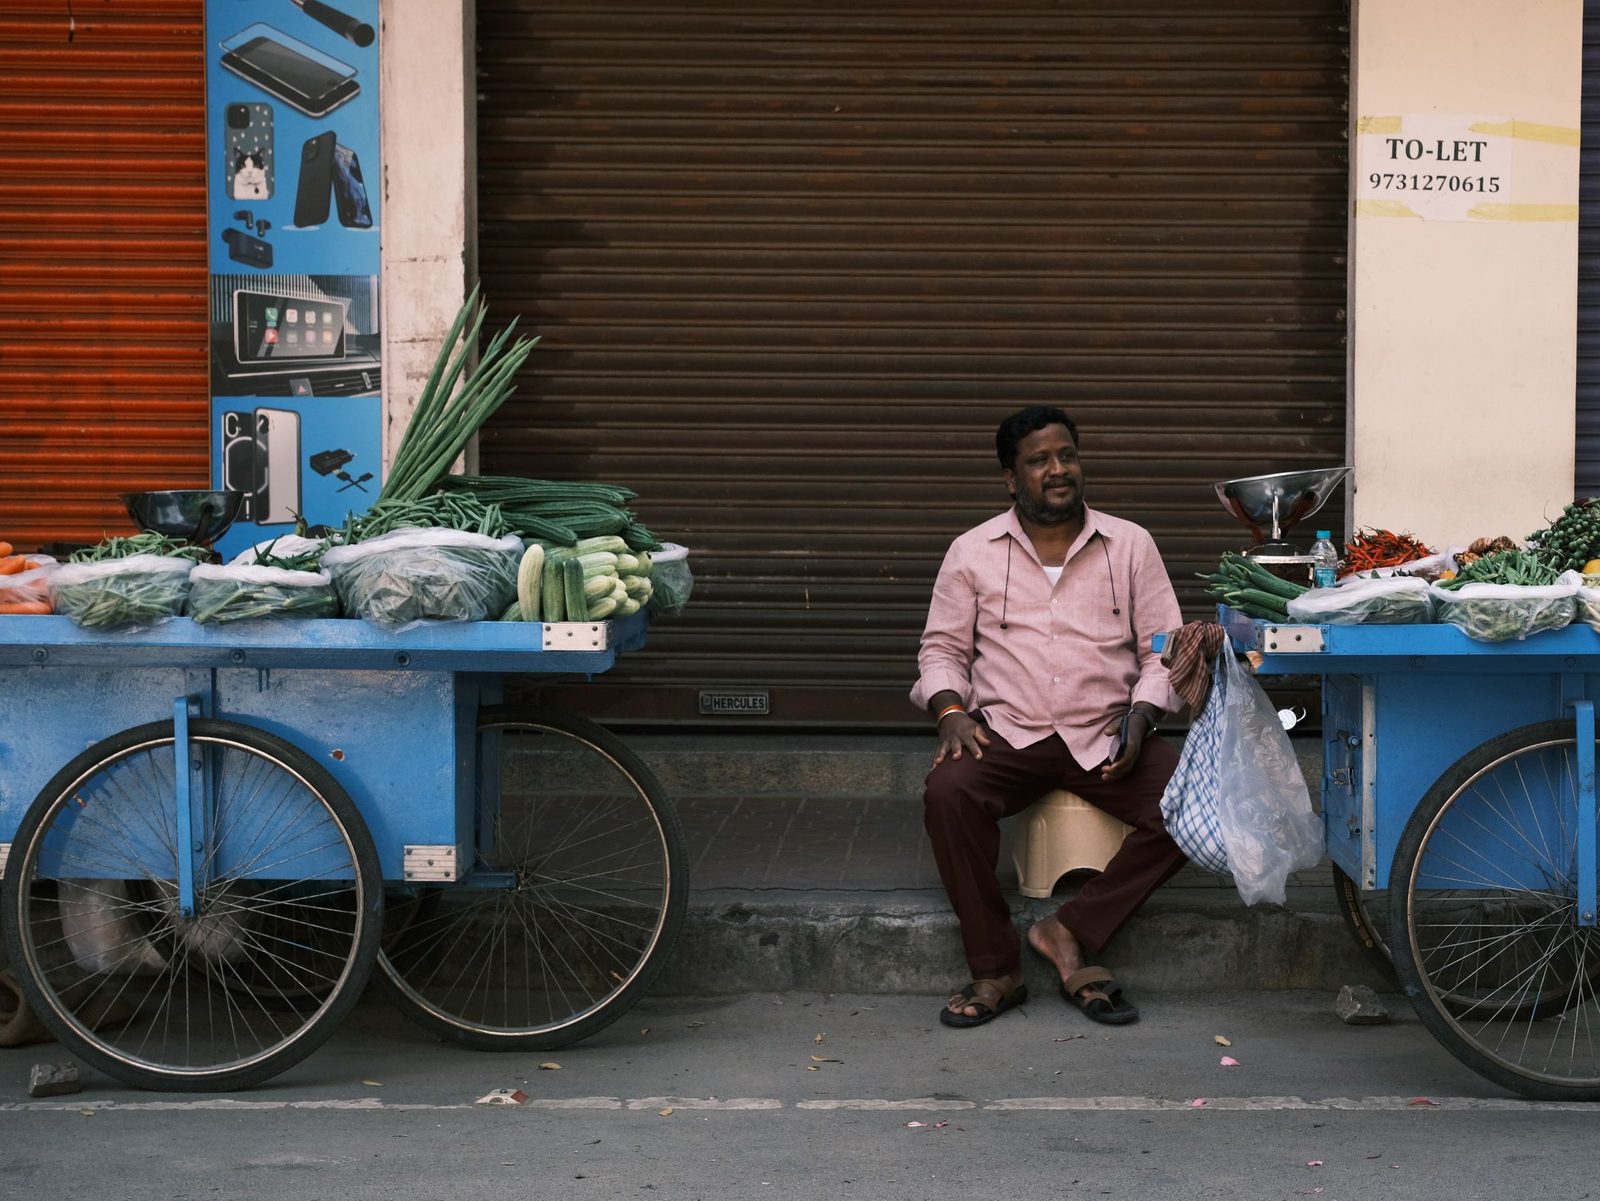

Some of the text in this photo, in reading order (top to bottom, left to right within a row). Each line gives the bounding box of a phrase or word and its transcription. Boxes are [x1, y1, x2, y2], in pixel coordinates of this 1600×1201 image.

[1386, 138, 1488, 162] TO-LET
[1369, 173, 1500, 193] 9731270615
[713, 697, 765, 709] HERCULES
